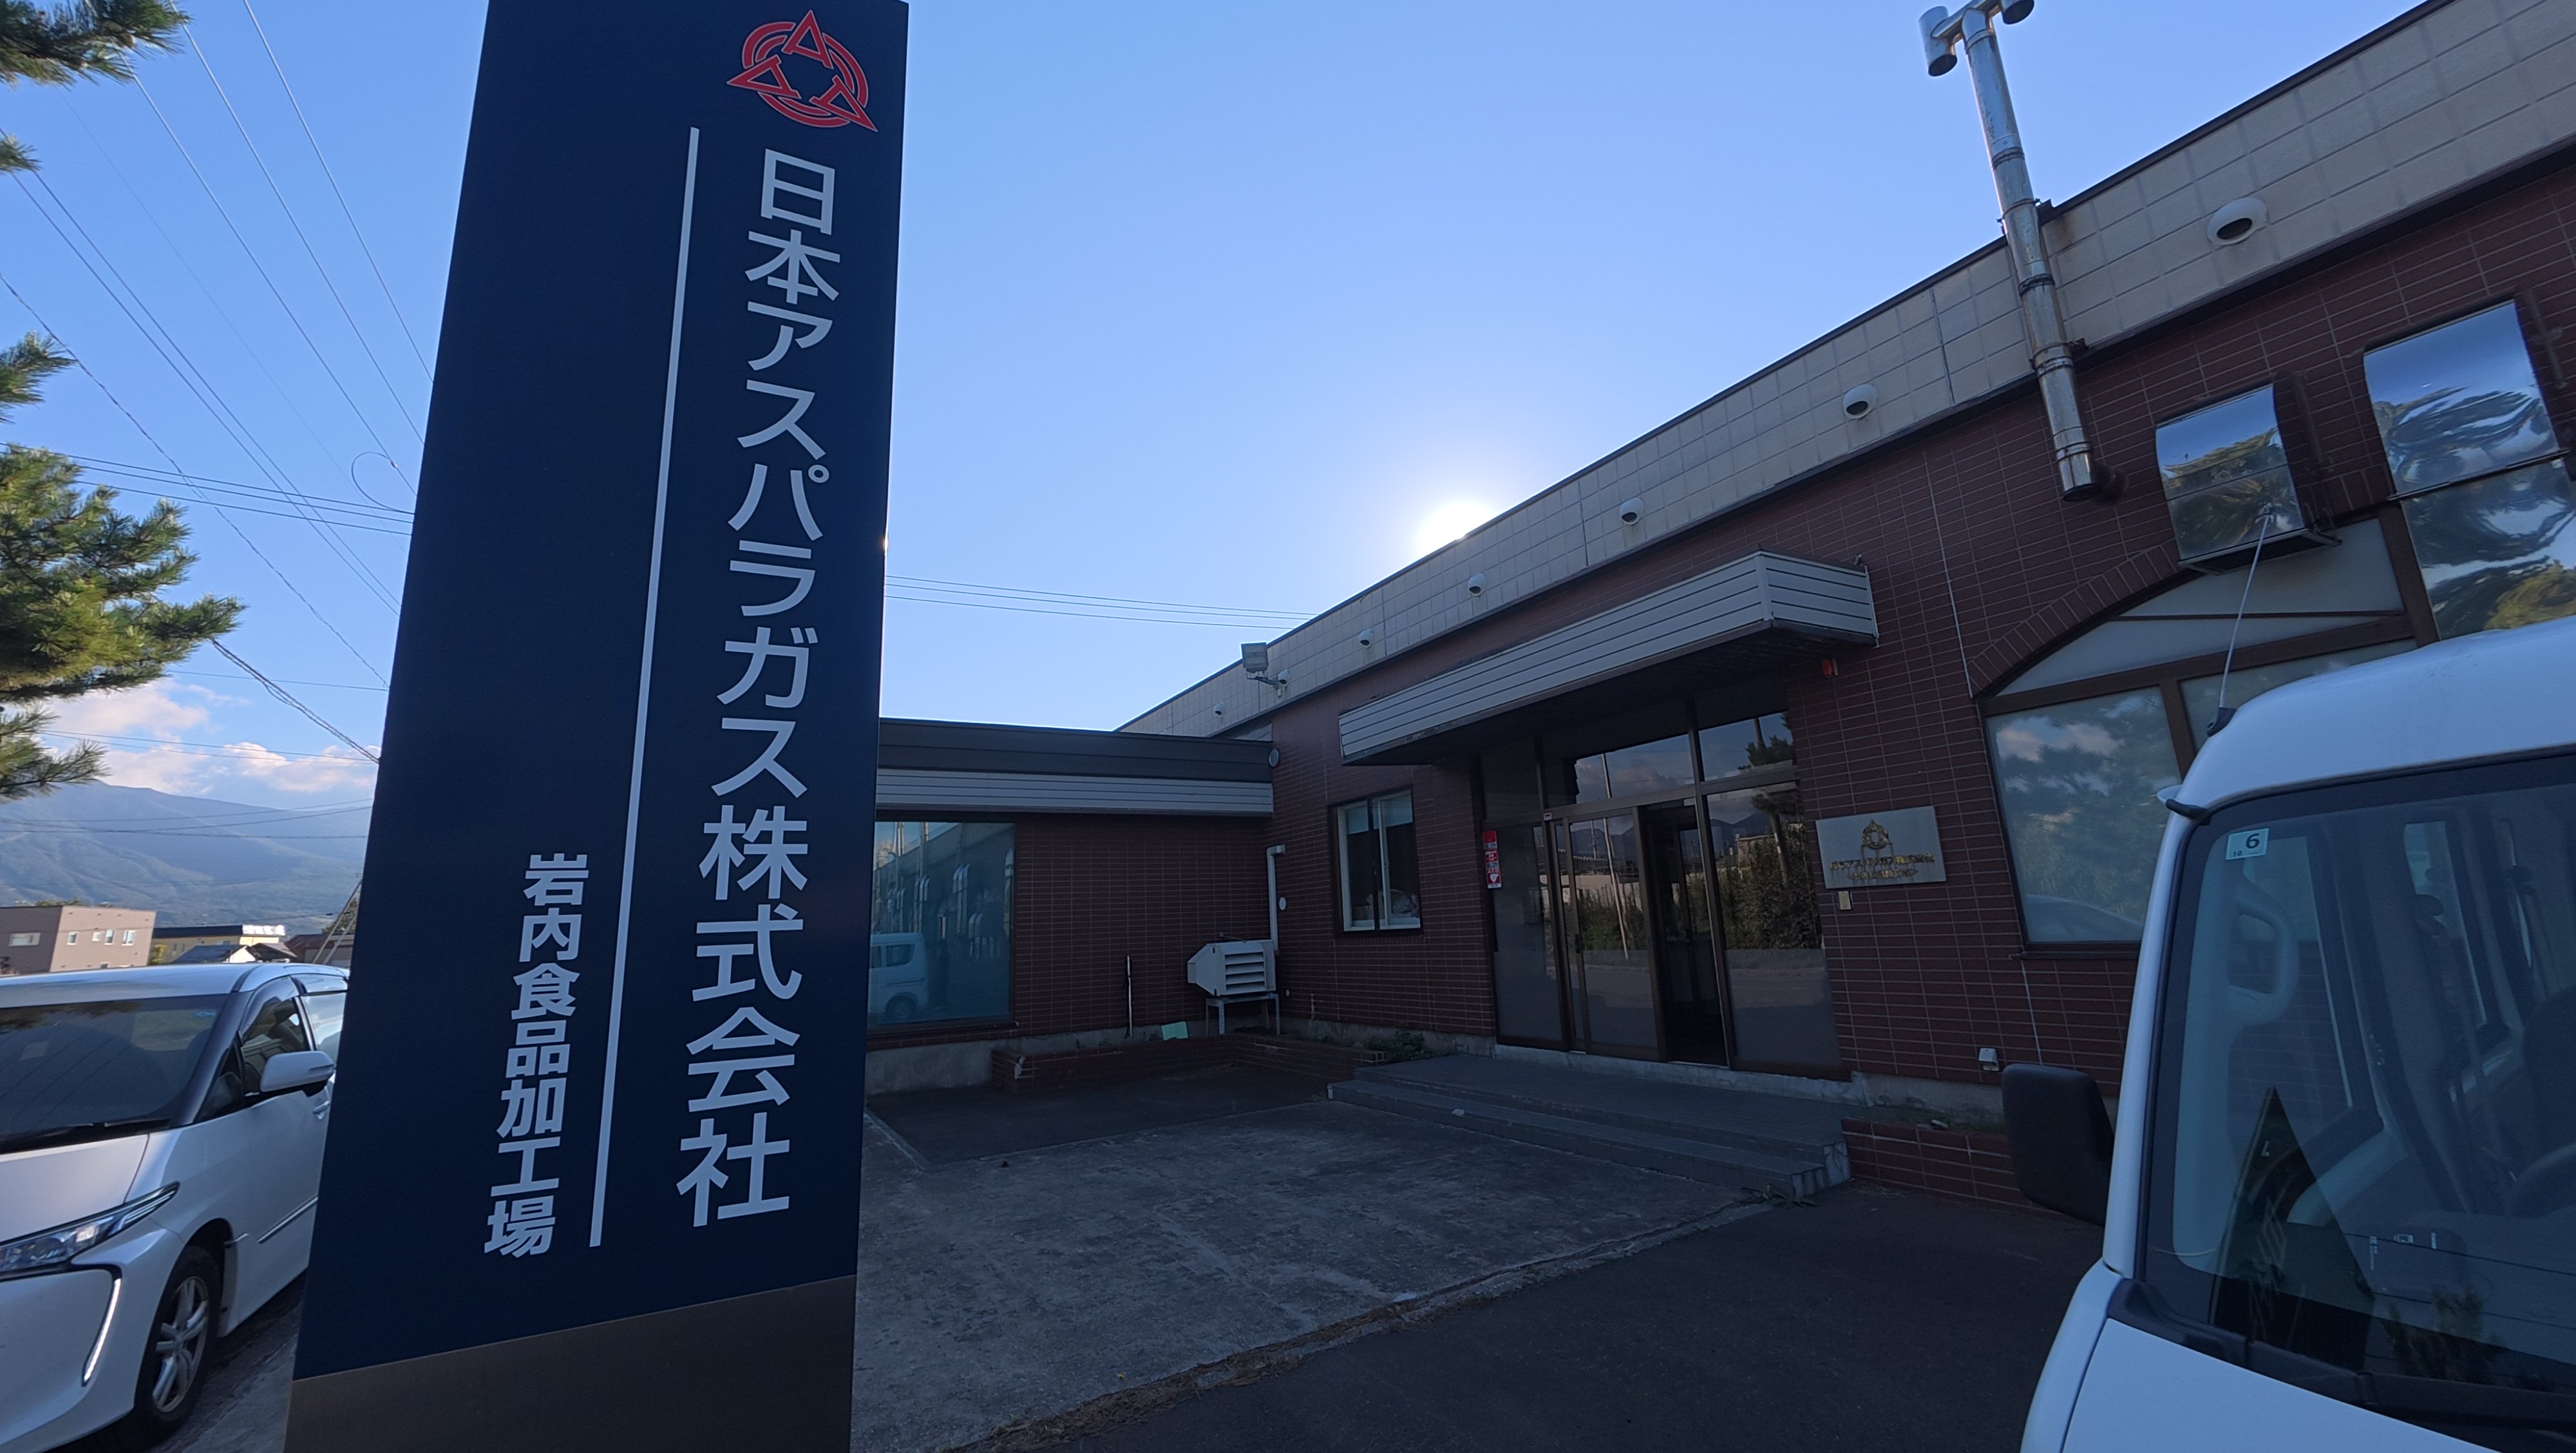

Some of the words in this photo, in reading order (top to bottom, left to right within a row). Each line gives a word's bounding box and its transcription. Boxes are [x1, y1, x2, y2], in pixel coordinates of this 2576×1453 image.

[676, 148, 841, 1228] 日本アスパラガス株式会社
[2245, 833, 2260, 849] 6
[484, 853, 589, 1258] 岩内食品加工場
